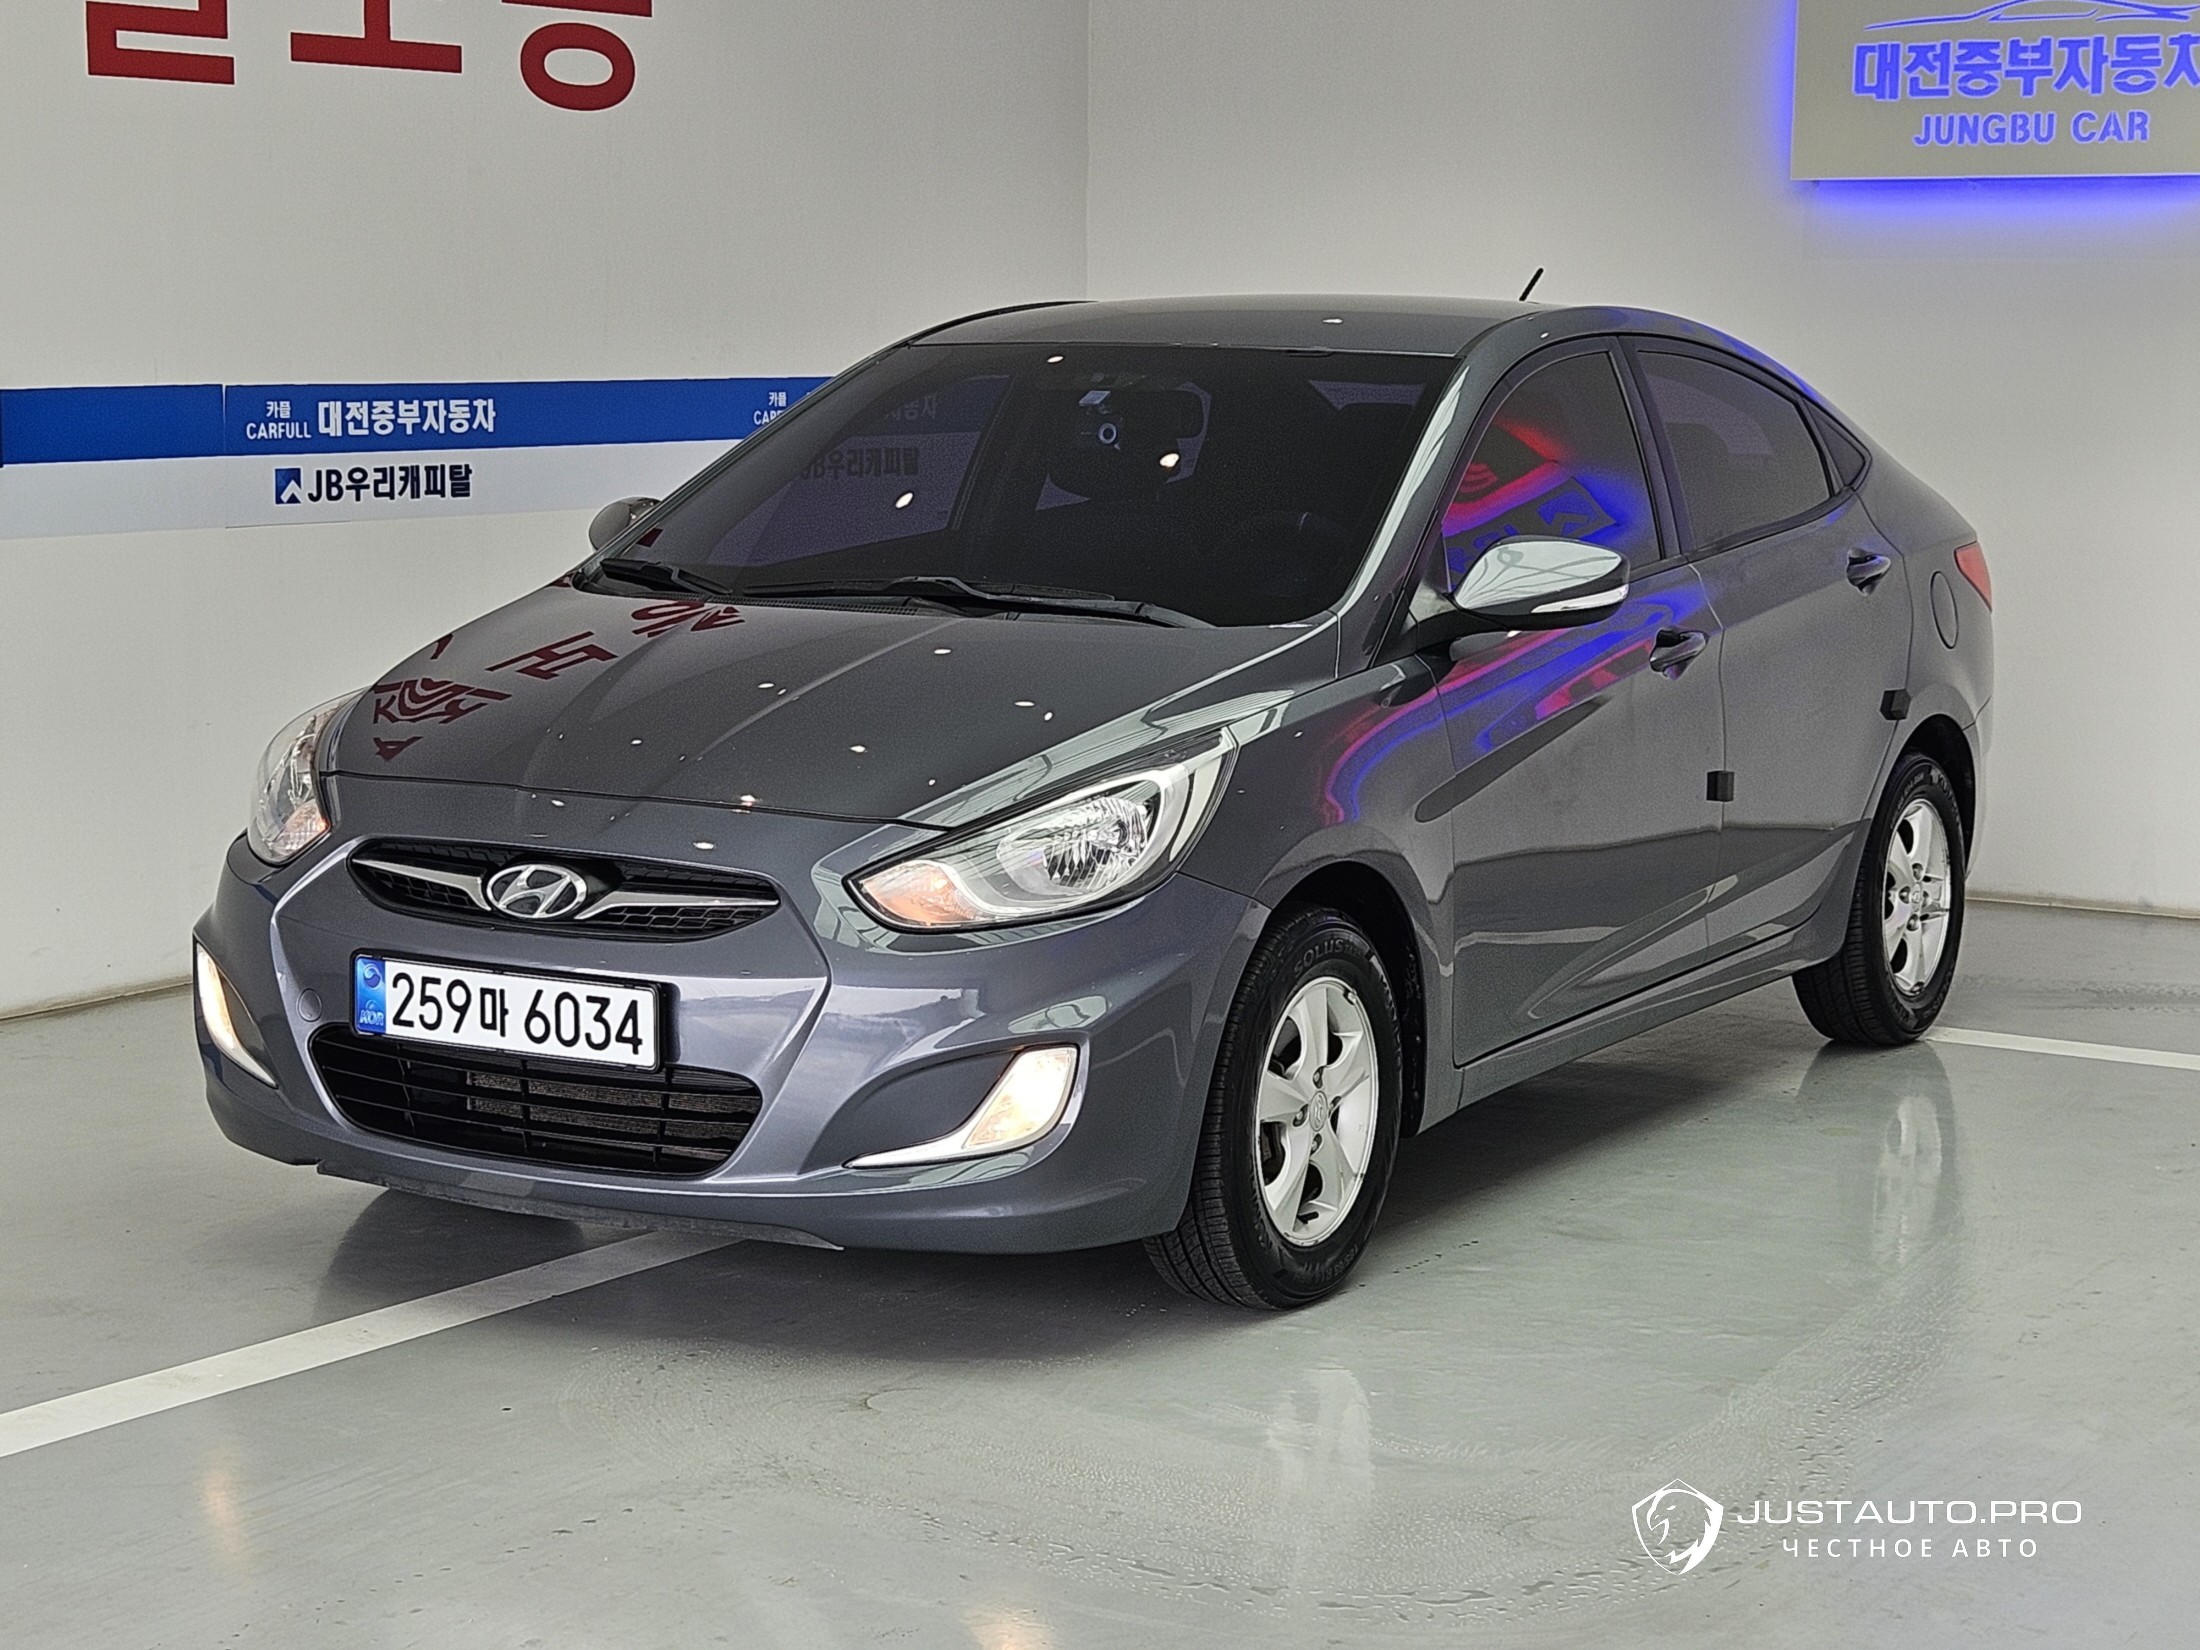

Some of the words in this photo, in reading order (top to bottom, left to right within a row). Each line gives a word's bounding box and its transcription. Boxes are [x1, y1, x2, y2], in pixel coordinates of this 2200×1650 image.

[1912, 112, 2056, 146] JUNGBU
[2071, 109, 2150, 143] CAR
[246, 422, 312, 439] CARFULL
[318, 398, 496, 437] 대전중부자동차
[308, 463, 473, 502] JB우리캐피탈
[391, 971, 509, 1038] 259마
[524, 988, 643, 1056] 6034
